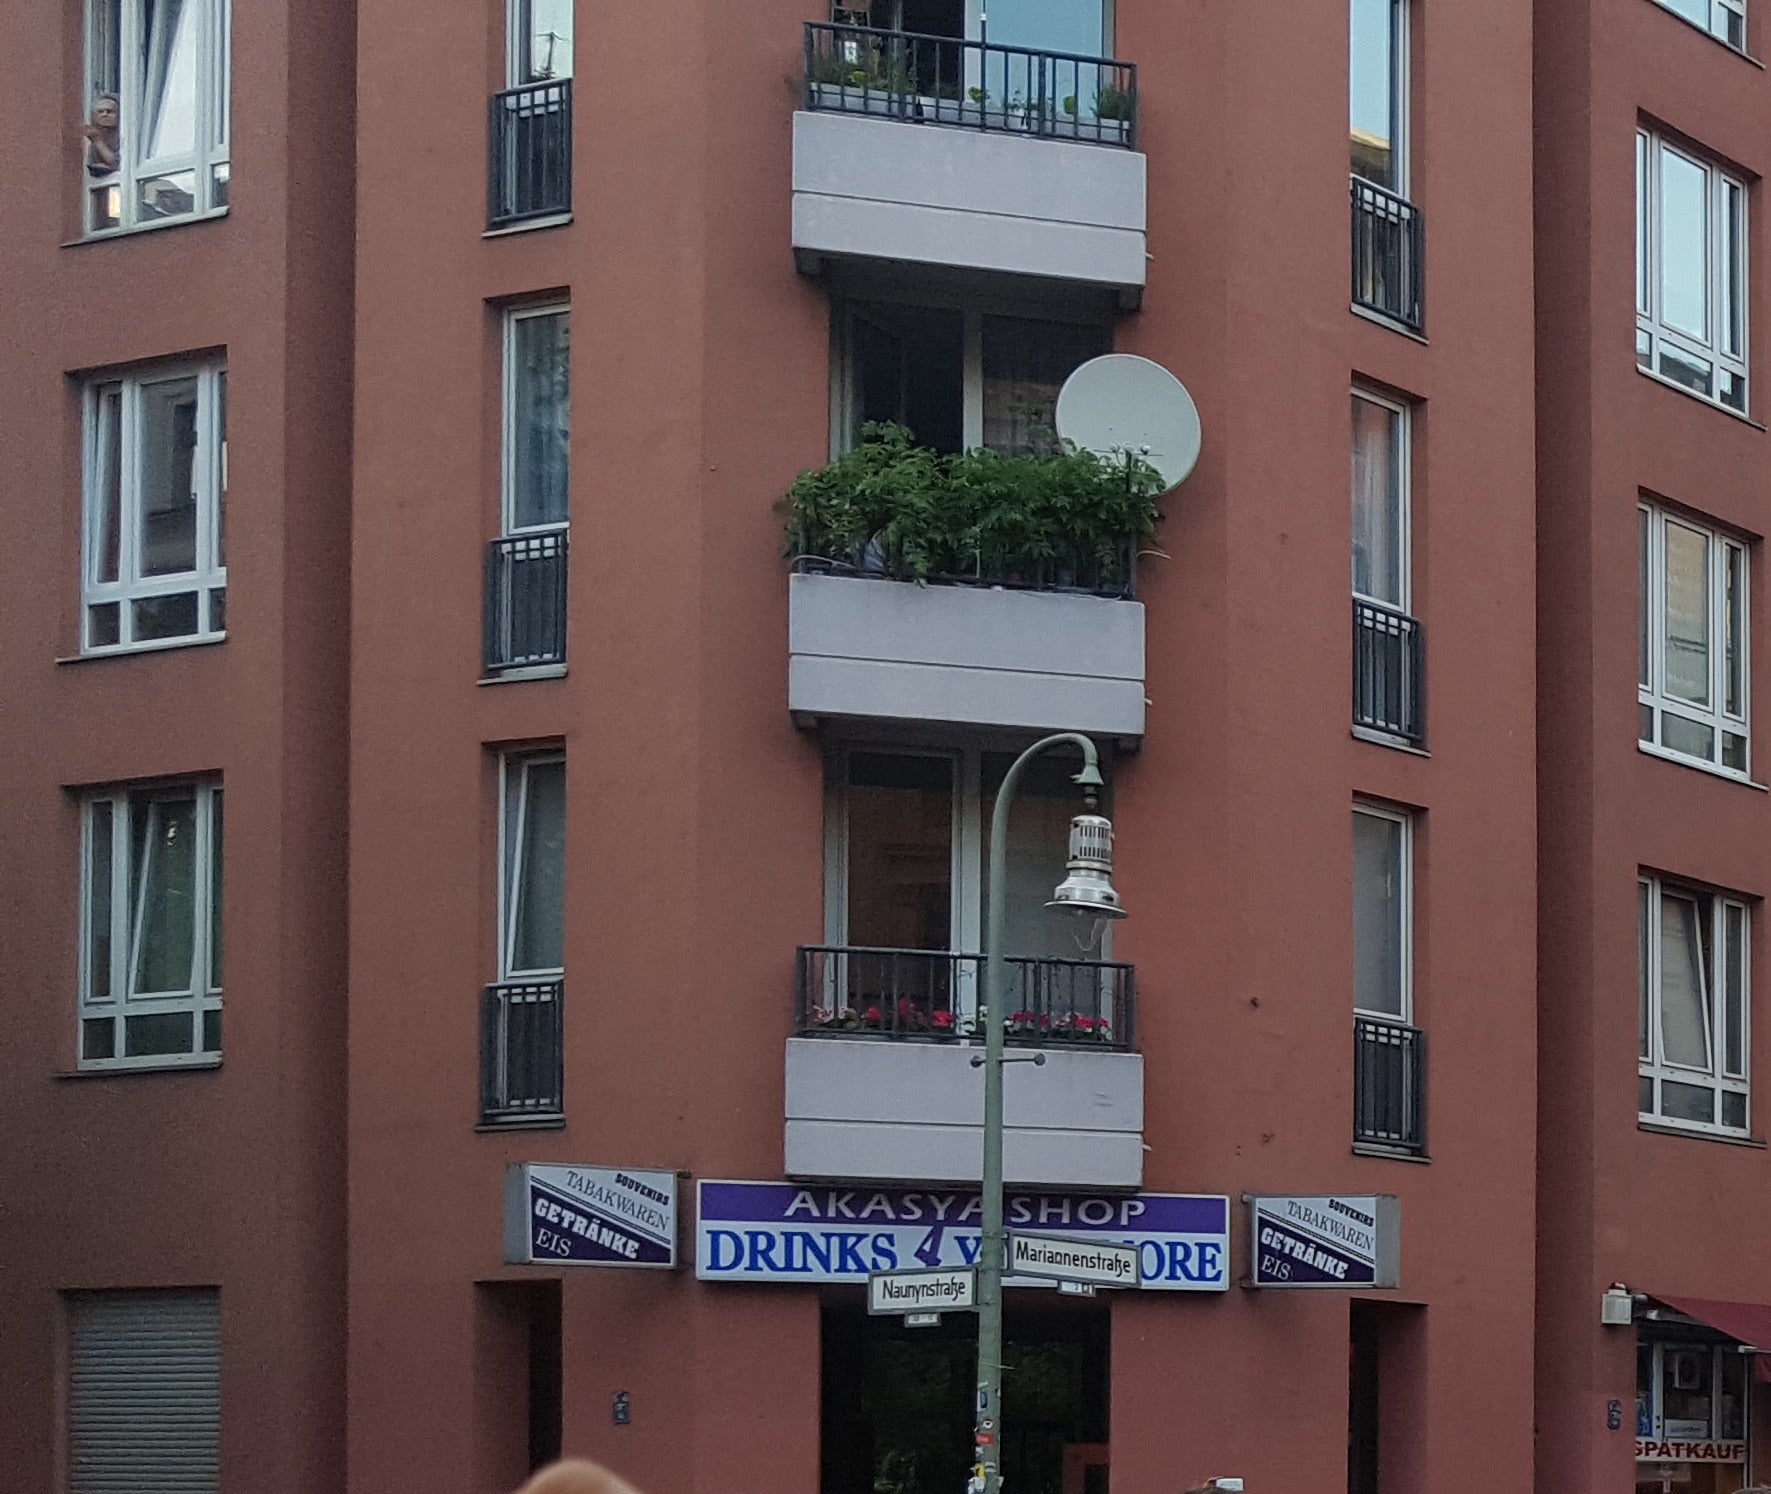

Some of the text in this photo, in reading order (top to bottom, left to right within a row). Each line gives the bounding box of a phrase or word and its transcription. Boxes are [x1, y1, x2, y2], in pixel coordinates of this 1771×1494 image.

[566, 1170, 670, 1231] TABAKWAREN
[615, 1172, 671, 1206] SOUVENIRS
[783, 1190, 1147, 1226] AKASYA SHOP
[1287, 1200, 1375, 1251] TABAKWAREN
[1328, 1198, 1375, 1228] SOUVENIRS
[534, 1198, 640, 1259] GETRÄNKE
[535, 1227, 572, 1257] EIS
[706, 1229, 898, 1274] DRINKS
[1140, 1238, 1223, 1283] ORE
[1015, 1240, 1132, 1278] Mariannenstraße
[1260, 1226, 1350, 1280] GETRÄNKE
[1261, 1254, 1292, 1281] EIS
[881, 1275, 966, 1303] Naunynstraße
